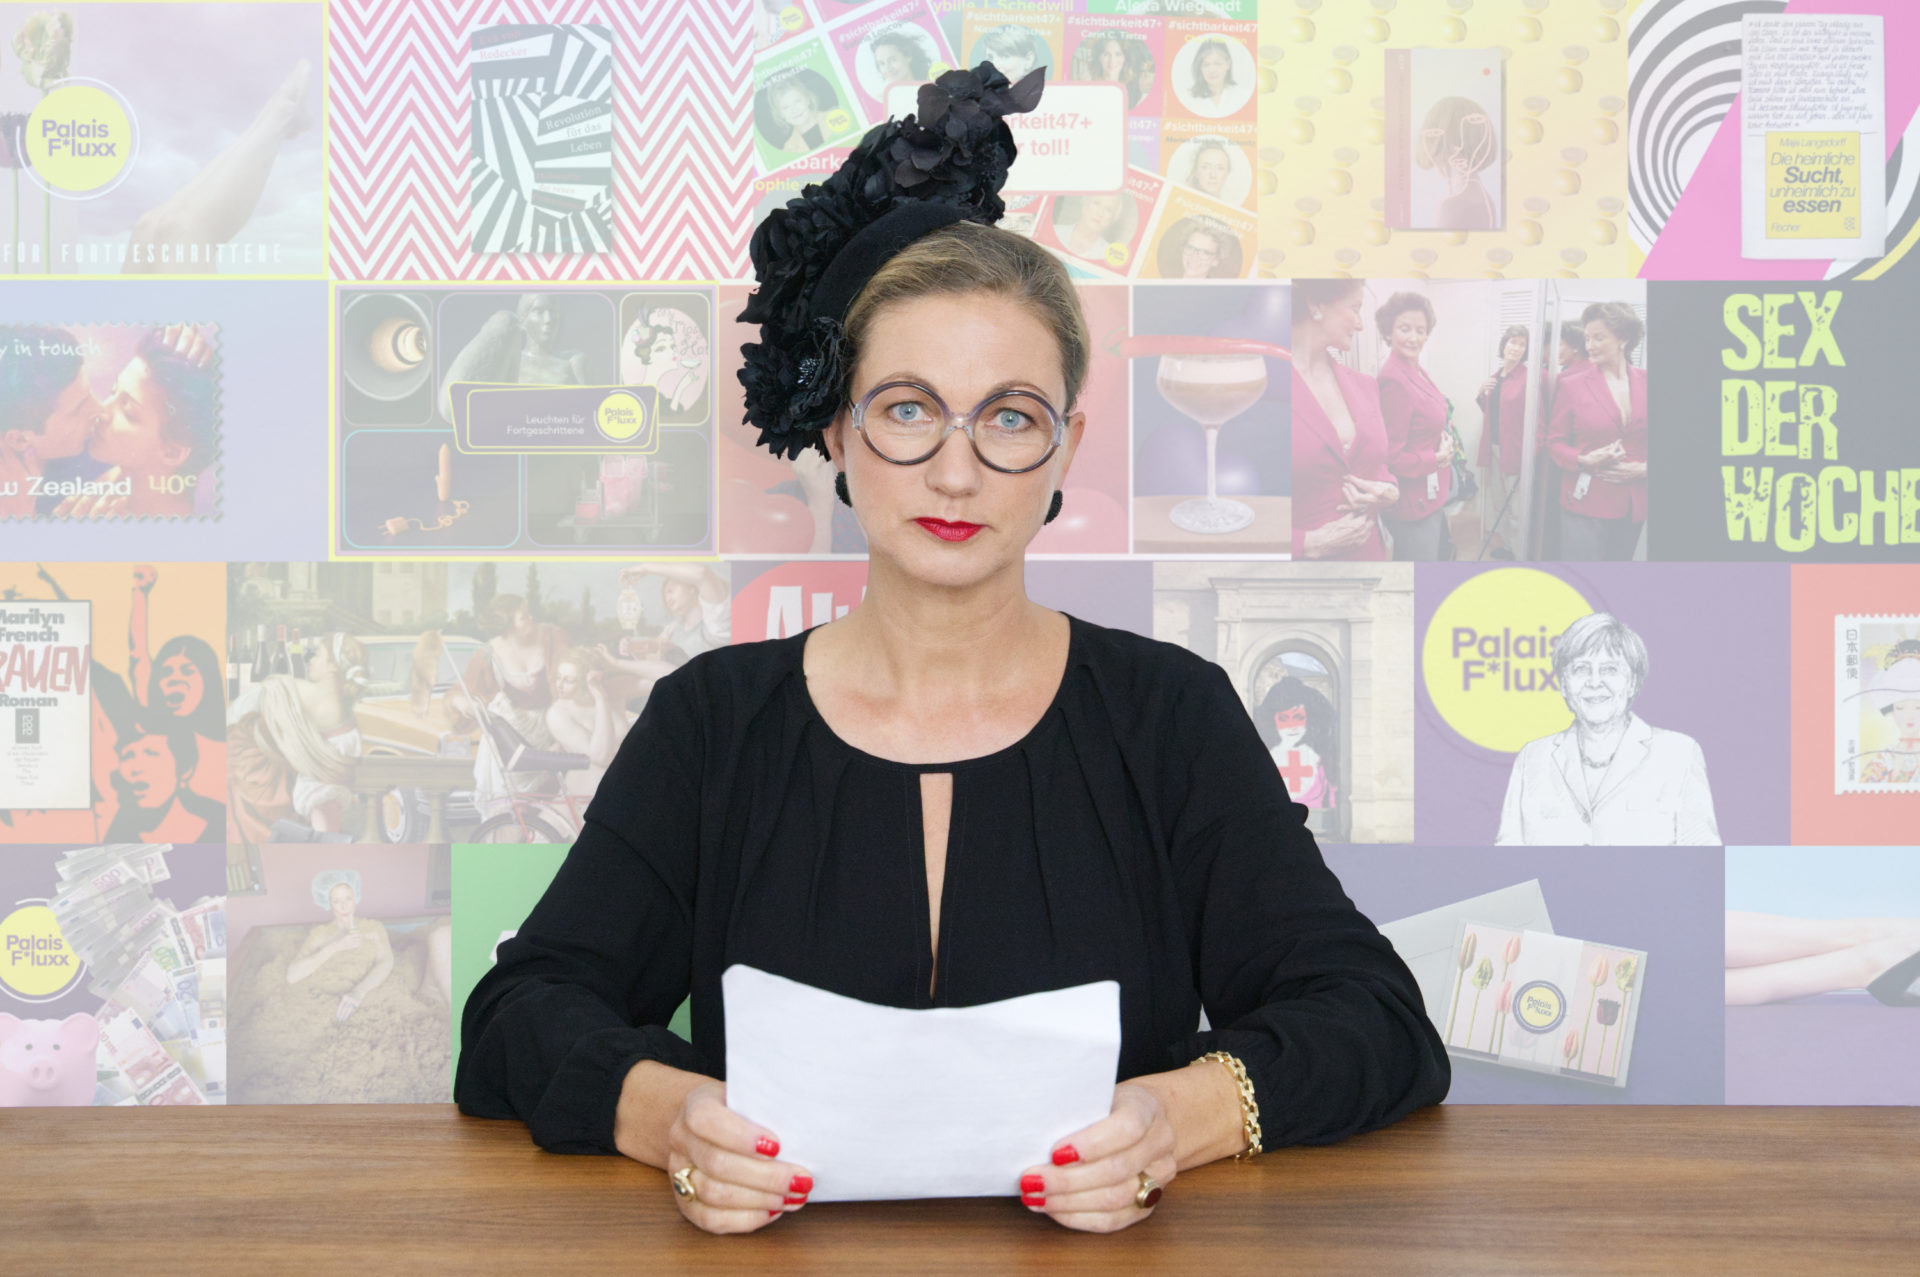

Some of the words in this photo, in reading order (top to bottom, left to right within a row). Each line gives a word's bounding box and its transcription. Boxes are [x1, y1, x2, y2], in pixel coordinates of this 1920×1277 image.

[1067, 16, 1163, 29] #sichtbarkeit47+
[546, 104, 602, 131] Revolution
[1003, 113, 1093, 129] rkeit47+
[42, 118, 109, 138] Palais
[571, 139, 602, 154] Leben
[1031, 138, 1069, 156] toll!
[1770, 152, 1793, 166] Die
[1794, 152, 1856, 166] heimliche
[1783, 166, 1845, 186] Sucht,
[1769, 184, 1839, 198] unheimlich
[1840, 186, 1857, 198] zu
[1783, 199, 1843, 214] essen
[3, 240, 41, 264] FÜR
[61, 242, 282, 265] FORTGESCHRITTENE
[1721, 290, 1847, 371] SEX
[13, 338, 32, 357] in
[39, 336, 103, 357] touch
[525, 414, 569, 425] Leuchten
[571, 414, 585, 425] für
[1721, 378, 1839, 461] DER
[506, 425, 585, 437] Fortgeschrittene
[26, 476, 133, 497] Zealand
[6, 933, 64, 951] Palais
